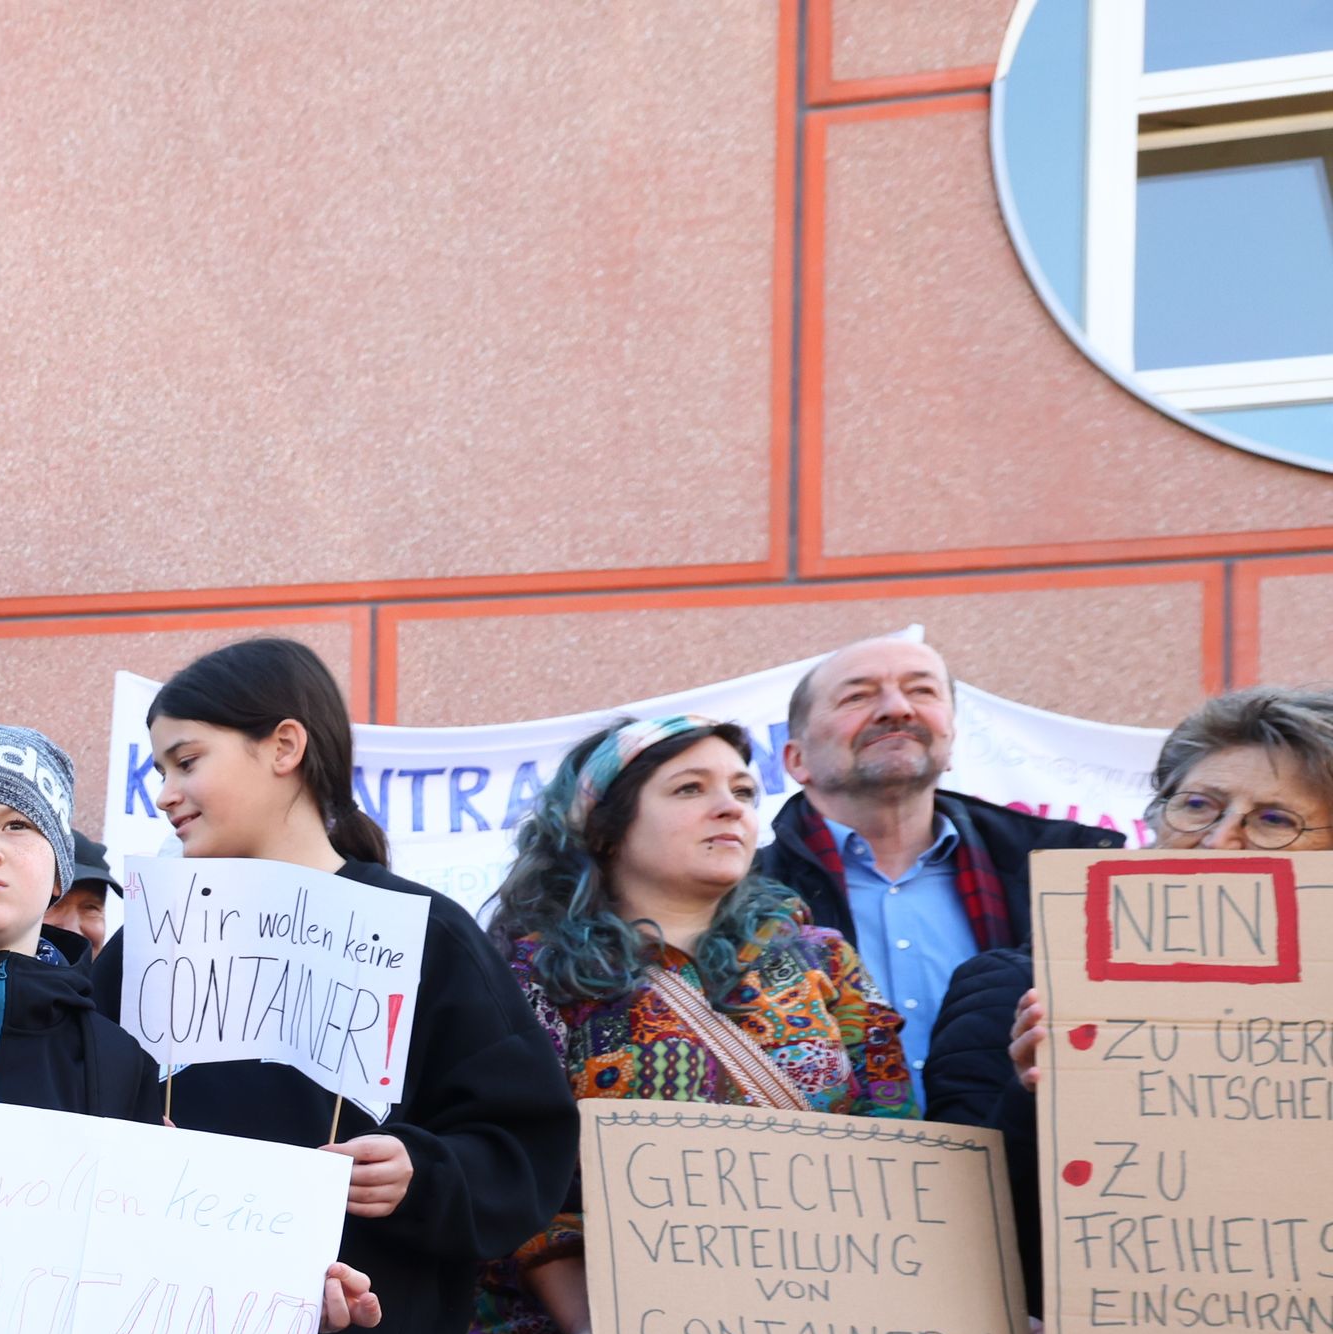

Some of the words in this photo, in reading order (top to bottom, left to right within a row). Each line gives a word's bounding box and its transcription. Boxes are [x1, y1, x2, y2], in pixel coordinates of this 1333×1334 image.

[137, 872, 241, 945] Wir
[259, 887, 333, 951] wollen
[343, 911, 405, 969] keine
[1111, 880, 1265, 957] NEIN
[1102, 1018, 1179, 1061] ZU
[1215, 1008, 1333, 1068] ÜBER
[627, 1142, 948, 1224] GERECHTE
[1093, 1141, 1187, 1202] ZU
[628, 1219, 923, 1277] VERTEILUNG
[755, 1278, 831, 1302] VON
